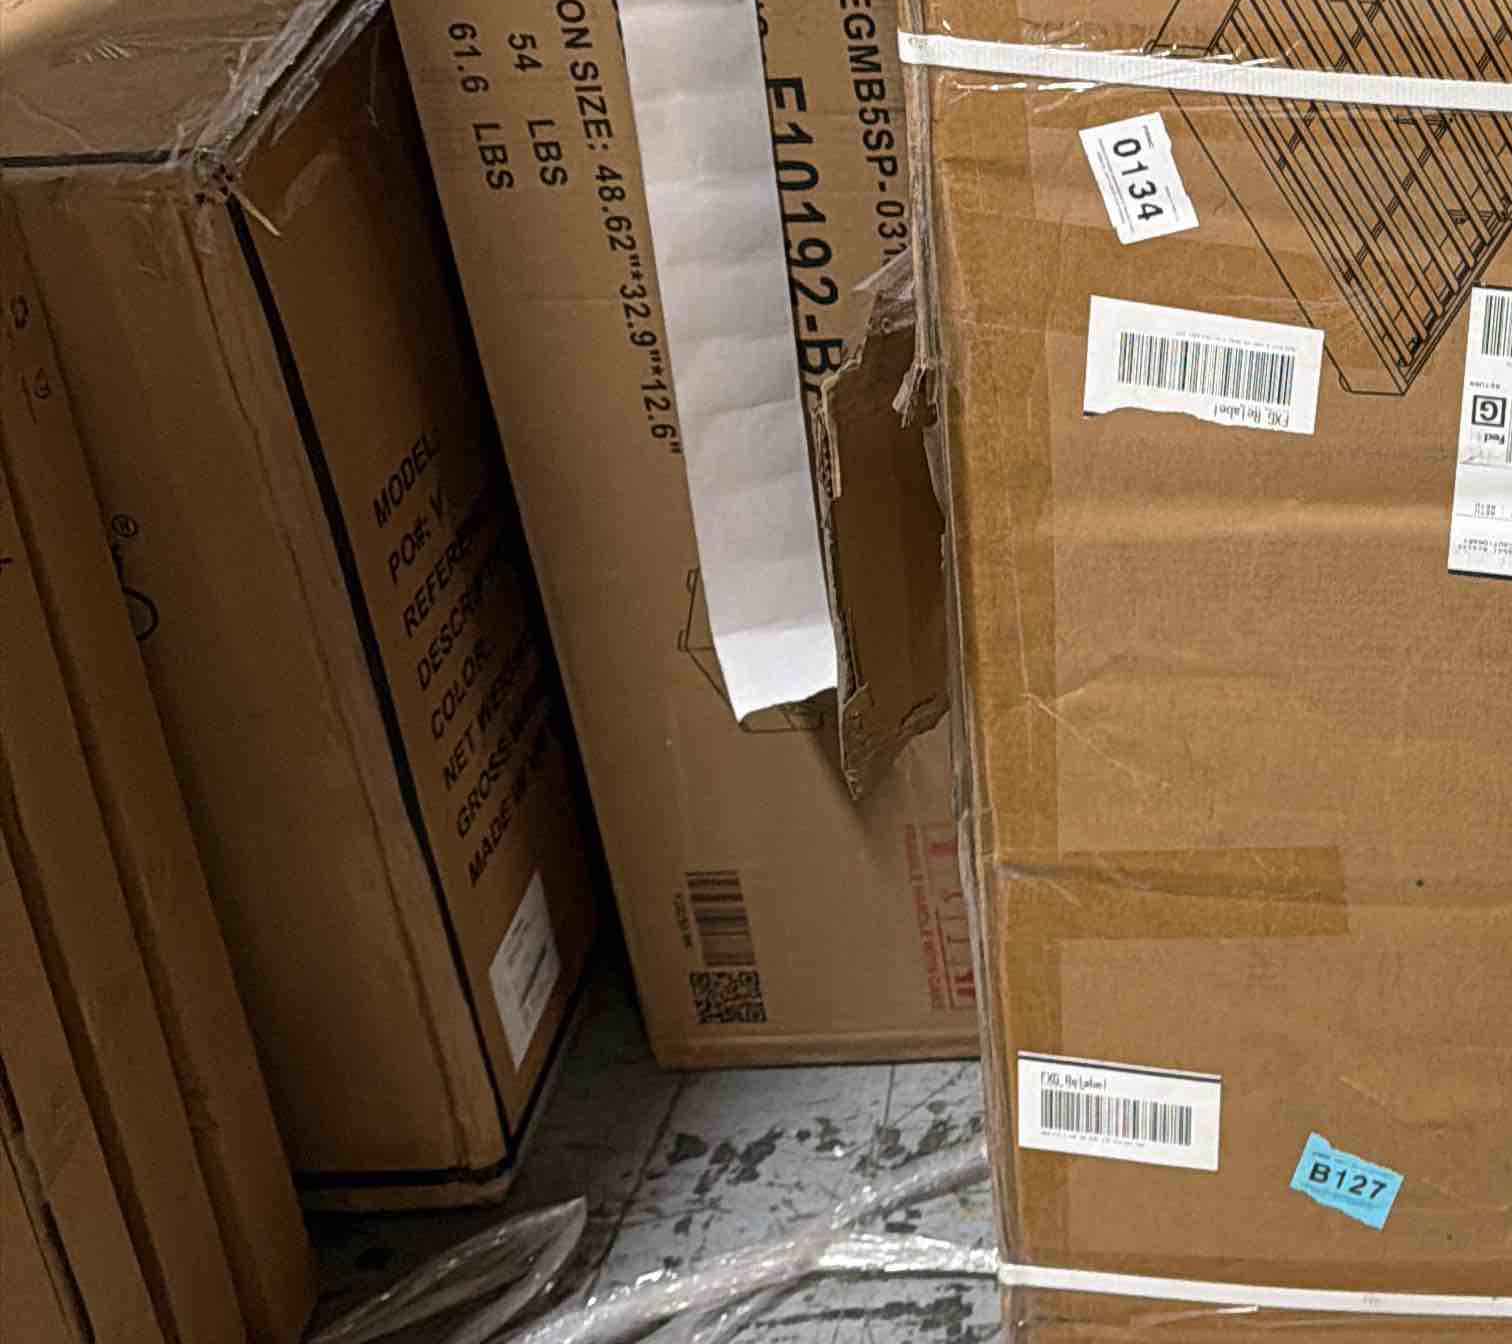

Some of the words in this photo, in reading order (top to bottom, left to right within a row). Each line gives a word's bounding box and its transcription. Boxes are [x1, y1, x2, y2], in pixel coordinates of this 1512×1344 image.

[447, 21, 489, 95] 61.6
[472, 120, 515, 191] LBS
[507, 32, 542, 73] 54
[527, 118, 568, 188] LBS
[569, 60, 612, 153] SIZE:
[1112, 137, 1164, 223] 0134
[1479, 400, 1499, 422] G
[1307, 1160, 1388, 1203] B127
